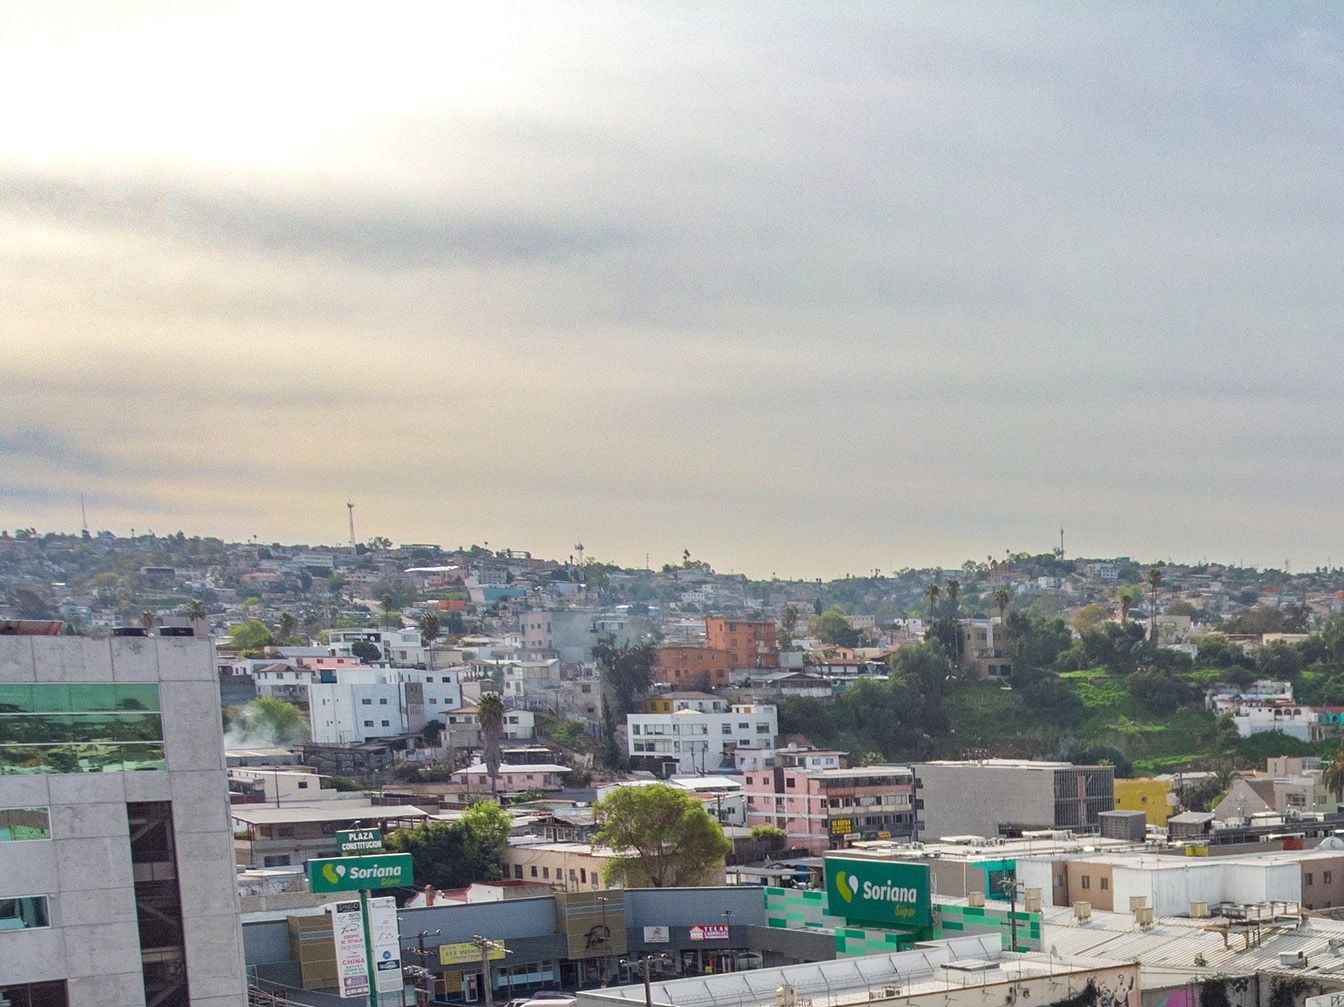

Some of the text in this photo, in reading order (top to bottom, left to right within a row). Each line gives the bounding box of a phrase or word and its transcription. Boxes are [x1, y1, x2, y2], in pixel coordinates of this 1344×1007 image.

[348, 832, 374, 841] PLAZA
[350, 864, 402, 879] Soriana
[863, 880, 917, 903] Soriana
[342, 958, 365, 966] CHINA
